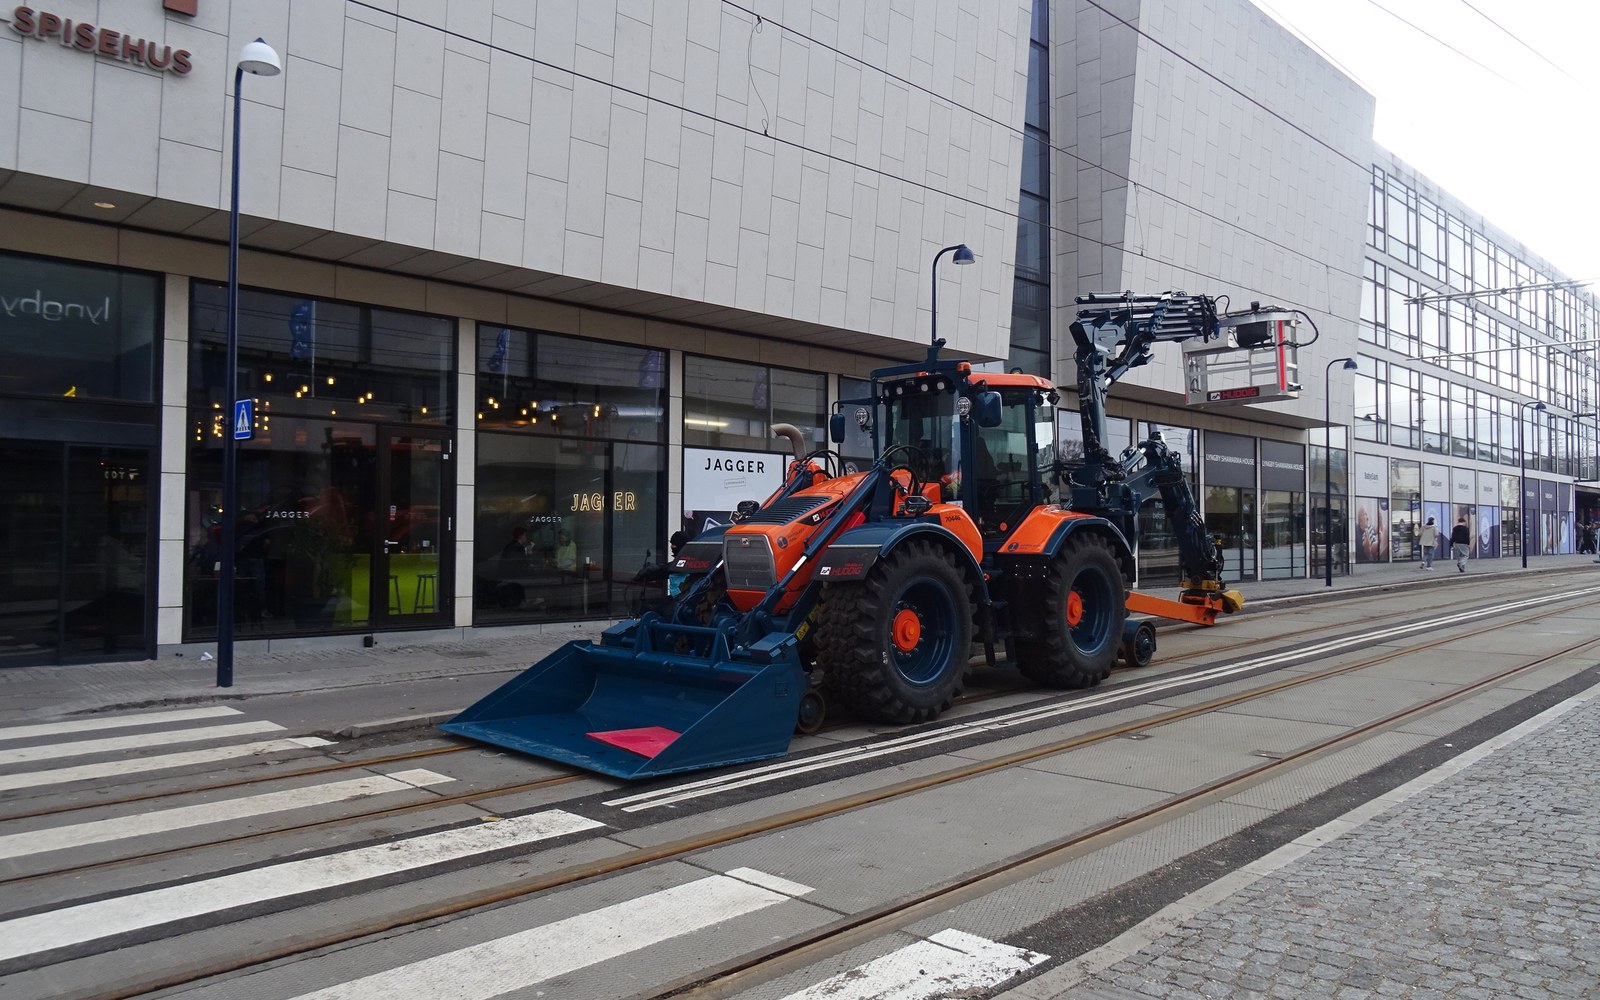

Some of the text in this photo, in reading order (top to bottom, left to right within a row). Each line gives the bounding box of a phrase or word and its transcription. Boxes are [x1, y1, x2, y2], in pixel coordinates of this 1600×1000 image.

[12, 5, 193, 76] SPISEHUS
[1221, 387, 1257, 399] HUDDIG
[704, 457, 765, 473] JAGGER
[1242, 457, 1255, 466] HOUSE
[571, 492, 635, 511] JAGER
[265, 511, 310, 519] JAGGER
[832, 567, 863, 576] HUDDIG
